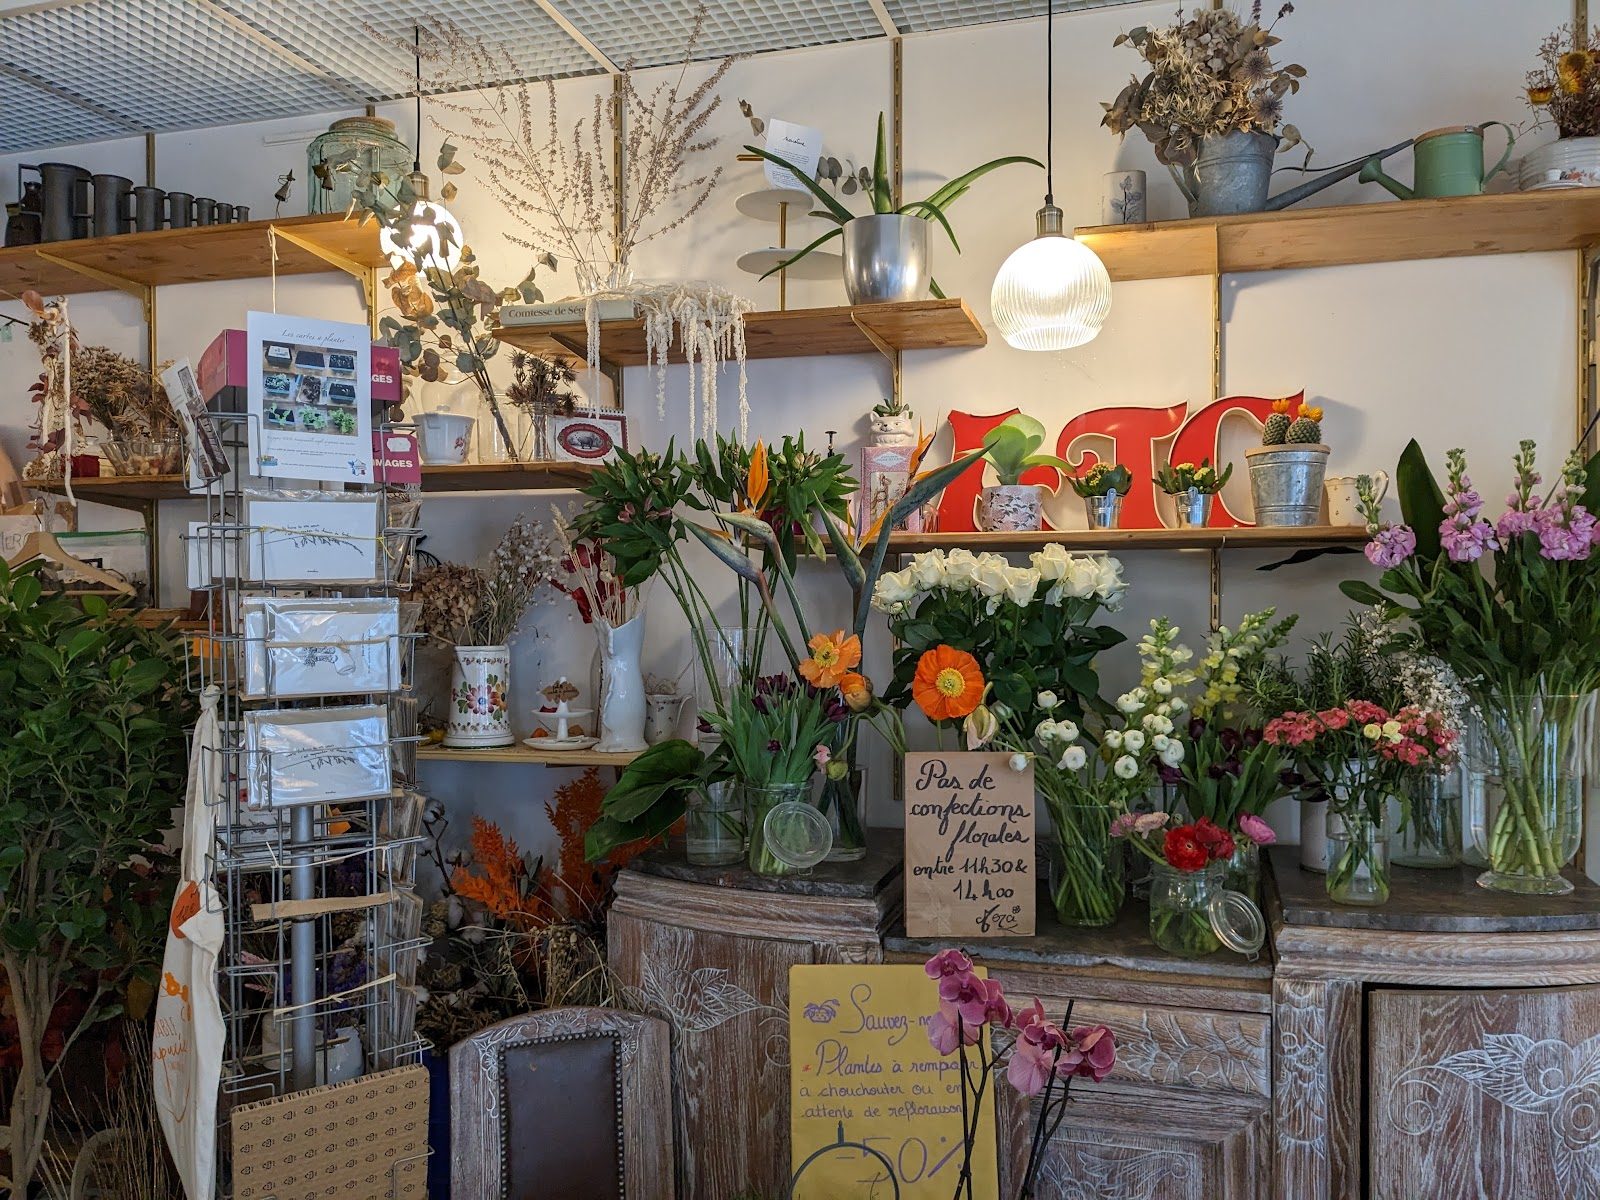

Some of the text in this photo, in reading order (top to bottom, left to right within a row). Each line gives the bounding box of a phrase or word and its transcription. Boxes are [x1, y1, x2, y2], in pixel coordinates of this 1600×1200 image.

[508, 307, 553, 319] Comtesse
[554, 306, 567, 316] de
[281, 329, 294, 338] Les
[295, 332, 315, 341] cartes
[915, 759, 996, 791] Pas de
[909, 792, 1031, 836] confections
[945, 819, 1030, 863] florales
[913, 855, 955, 880] entre
[1014, 858, 1028, 874] &
[815, 1038, 979, 1081] Plantes à rempor
[817, 1082, 905, 1098] chouchouter
[912, 1084, 933, 1095] ou
[802, 1100, 962, 1122] attente de refloraison
